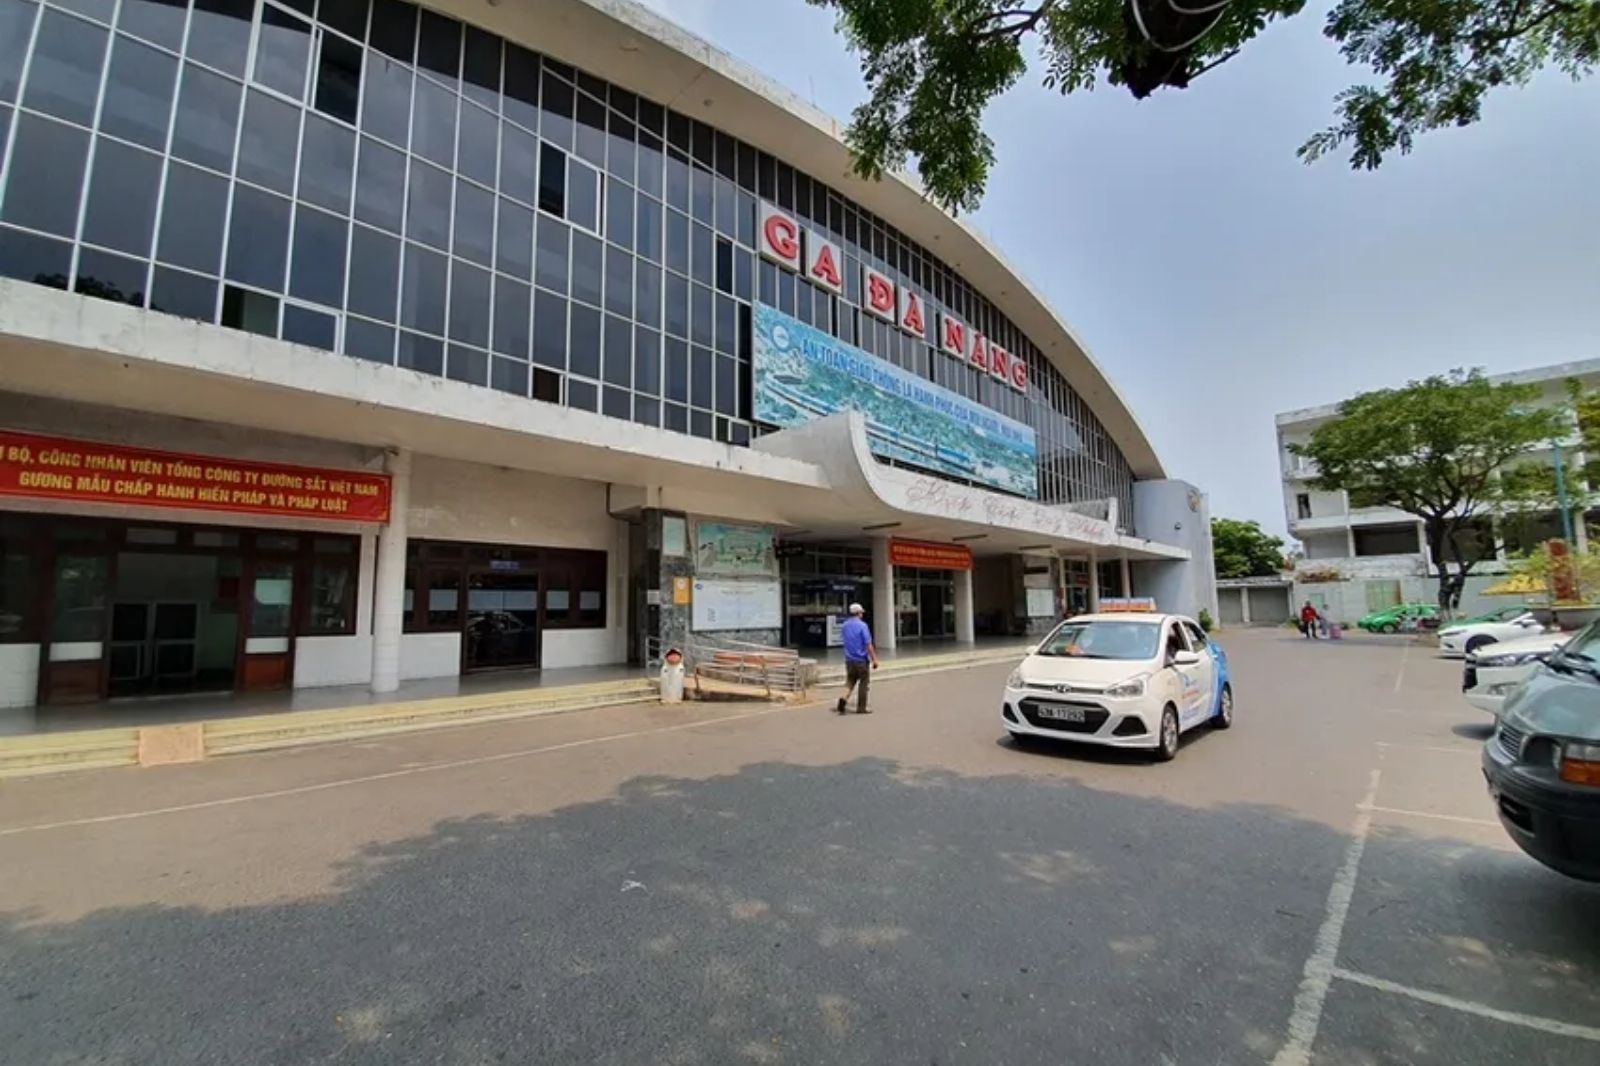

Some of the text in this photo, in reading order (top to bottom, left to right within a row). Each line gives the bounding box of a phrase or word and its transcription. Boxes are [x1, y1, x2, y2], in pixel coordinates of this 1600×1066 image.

[764, 214, 841, 287] GA
[869, 273, 924, 334] ĐÀ
[20, 471, 73, 490] GƯƠNG
[114, 477, 153, 496] CHẤP
[156, 483, 195, 499] HÀNH
[198, 486, 230, 502] HIẾN
[232, 490, 266, 505] PHÁP
[269, 493, 285, 507] VÀ
[287, 494, 319, 509] PHÁP
[321, 497, 348, 513] LUẬT
[39, 448, 81, 467] CÔNG
[84, 453, 126, 472] NHÂN
[130, 458, 162, 475] VIÊN
[166, 460, 202, 479] TỔNG
[204, 466, 241, 483] CÔNG
[244, 471, 259, 484] TY
[305, 475, 327, 491] SẮT
[328, 480, 352, 495] VIỆT
[354, 483, 379, 496] NAM
